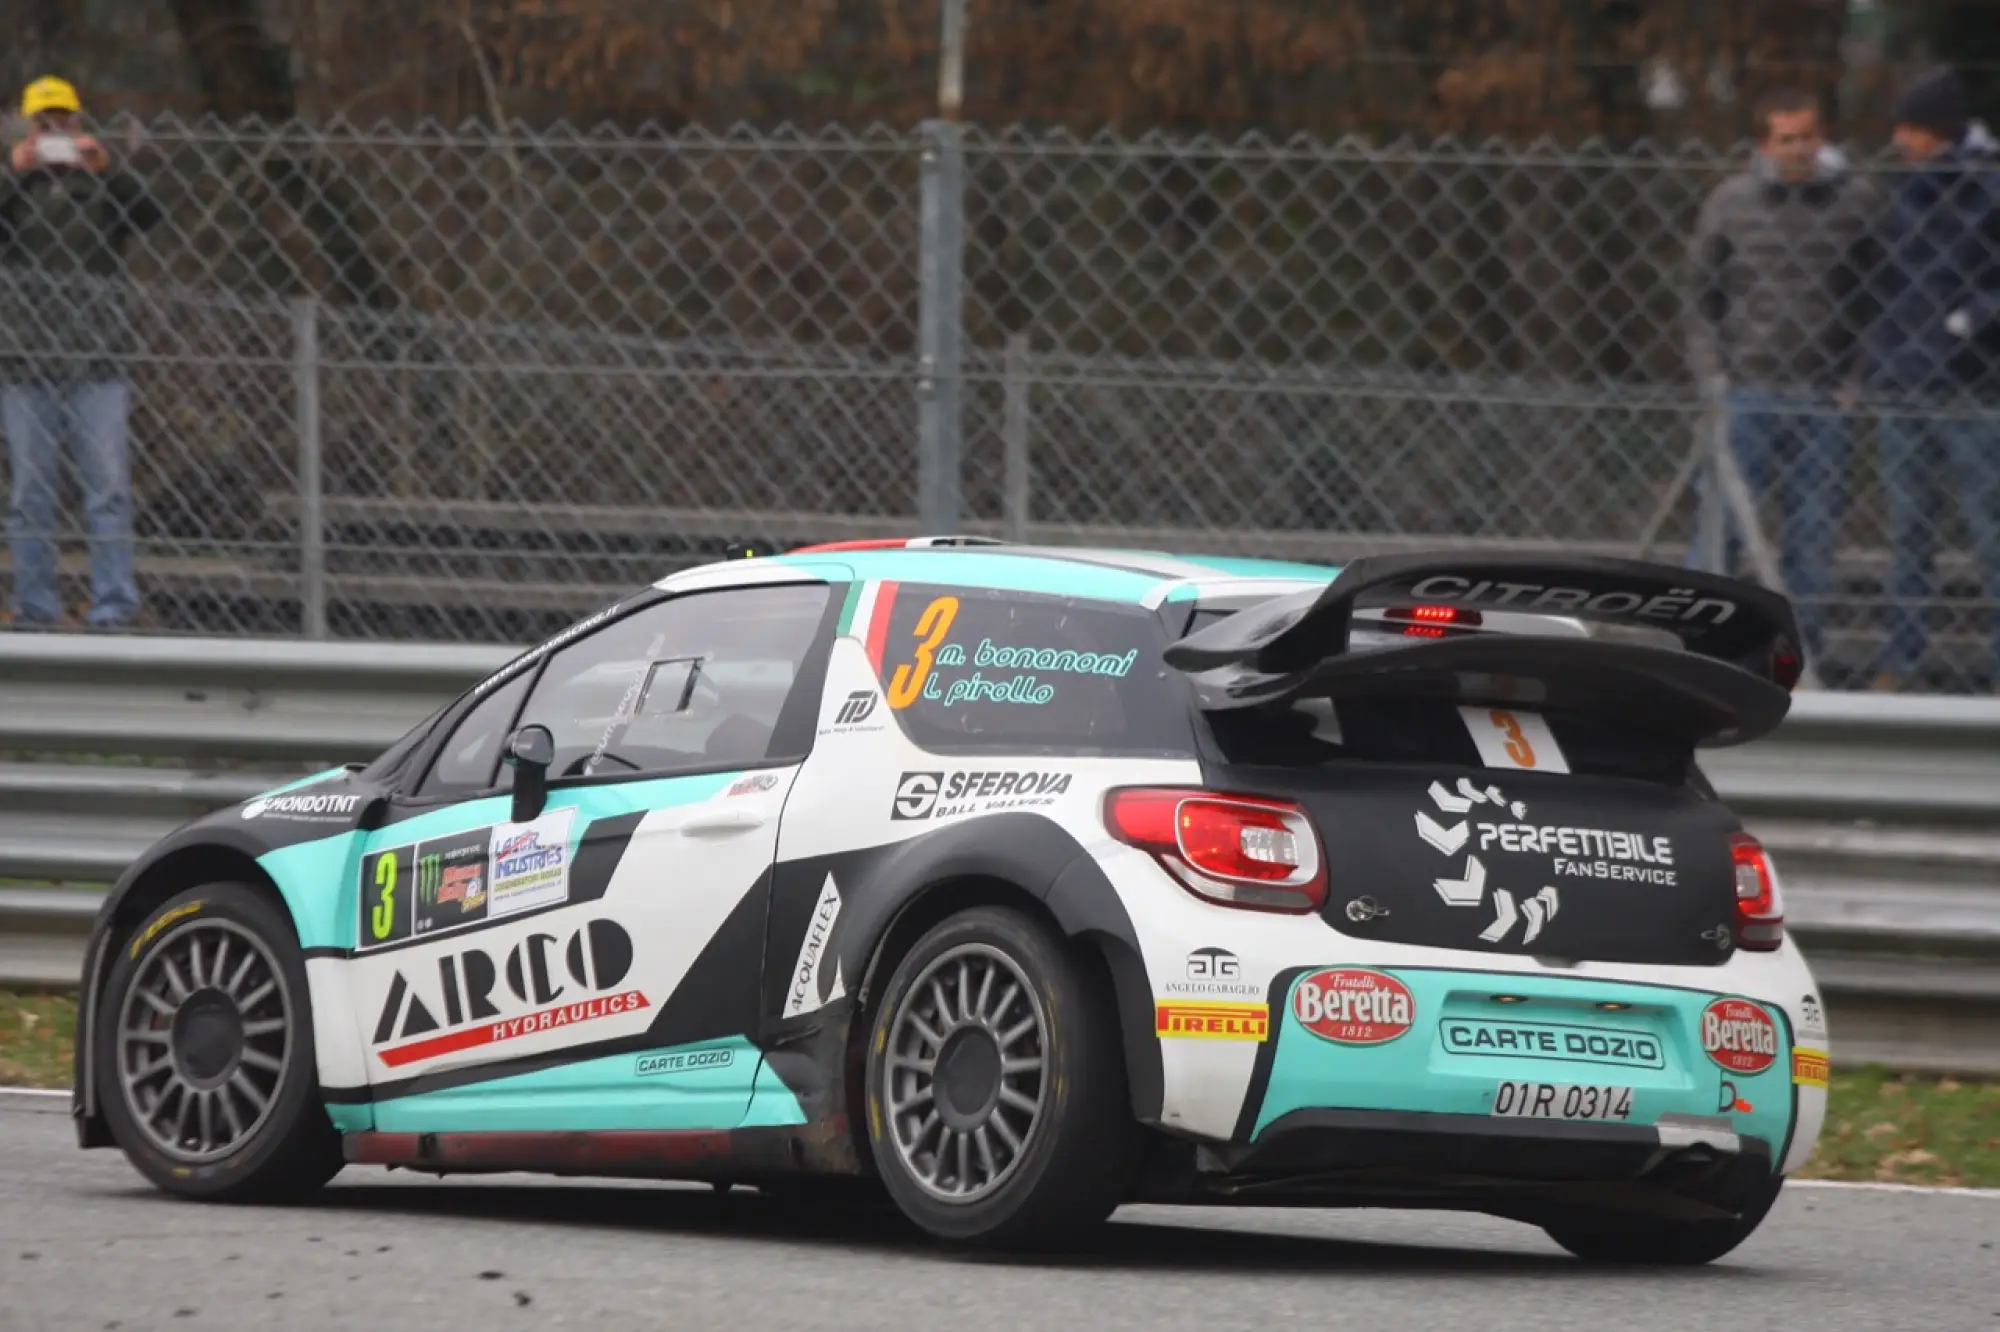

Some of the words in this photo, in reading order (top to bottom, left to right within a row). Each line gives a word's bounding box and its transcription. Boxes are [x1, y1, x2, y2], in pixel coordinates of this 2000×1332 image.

[886, 595, 960, 710] 3
[936, 643, 966, 666] m.
[974, 637, 1139, 677] bonanomi
[943, 672, 1054, 707] pirollo
[1489, 708, 1537, 769] 3
[945, 771, 1073, 799] SFEROVA
[935, 803, 976, 818] BALL
[1476, 822, 1675, 865] PERFETTIBILE
[371, 851, 398, 940] 3
[791, 891, 837, 1014] ACQUAFLEX
[372, 918, 634, 1045] ARCO
[1164, 982, 1206, 993] ANGELO
[1330, 973, 1376, 989] Fratelli
[492, 990, 640, 1041] HYDRAULICS
[1157, 1005, 1267, 1035] PIRELLI
[1298, 980, 1411, 1026] Beretta
[1340, 1024, 1374, 1038] 1812
[1449, 1025, 1558, 1052] CARTE
[1563, 1033, 1657, 1061] DOZIO
[1702, 1011, 1775, 1056] Beretta
[638, 1056, 684, 1072] CARTE
[686, 1049, 731, 1067] DOZIO
[1495, 1081, 1557, 1116] 01R
[1562, 1086, 1632, 1119] 0314
